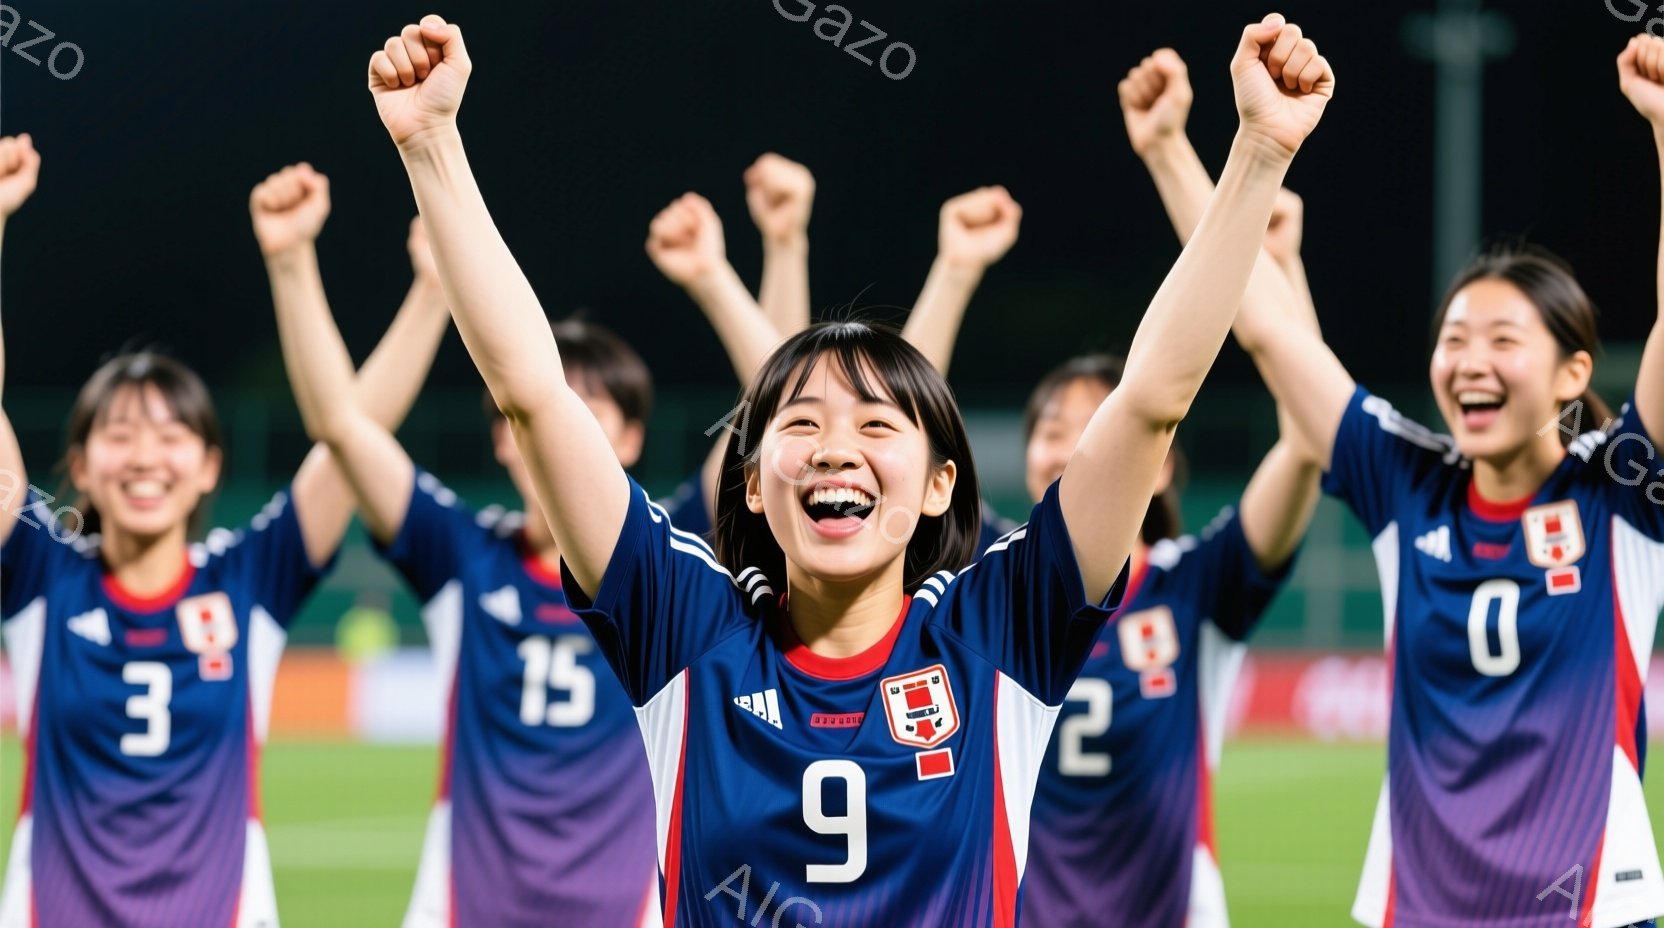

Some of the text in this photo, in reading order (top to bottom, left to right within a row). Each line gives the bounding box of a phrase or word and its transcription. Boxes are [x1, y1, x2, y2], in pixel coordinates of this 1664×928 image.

[1467, 579, 1520, 677] 0
[120, 661, 172, 757] 3
[517, 634, 596, 727] 15
[1058, 677, 1113, 777] 2
[803, 760, 867, 882] 9
